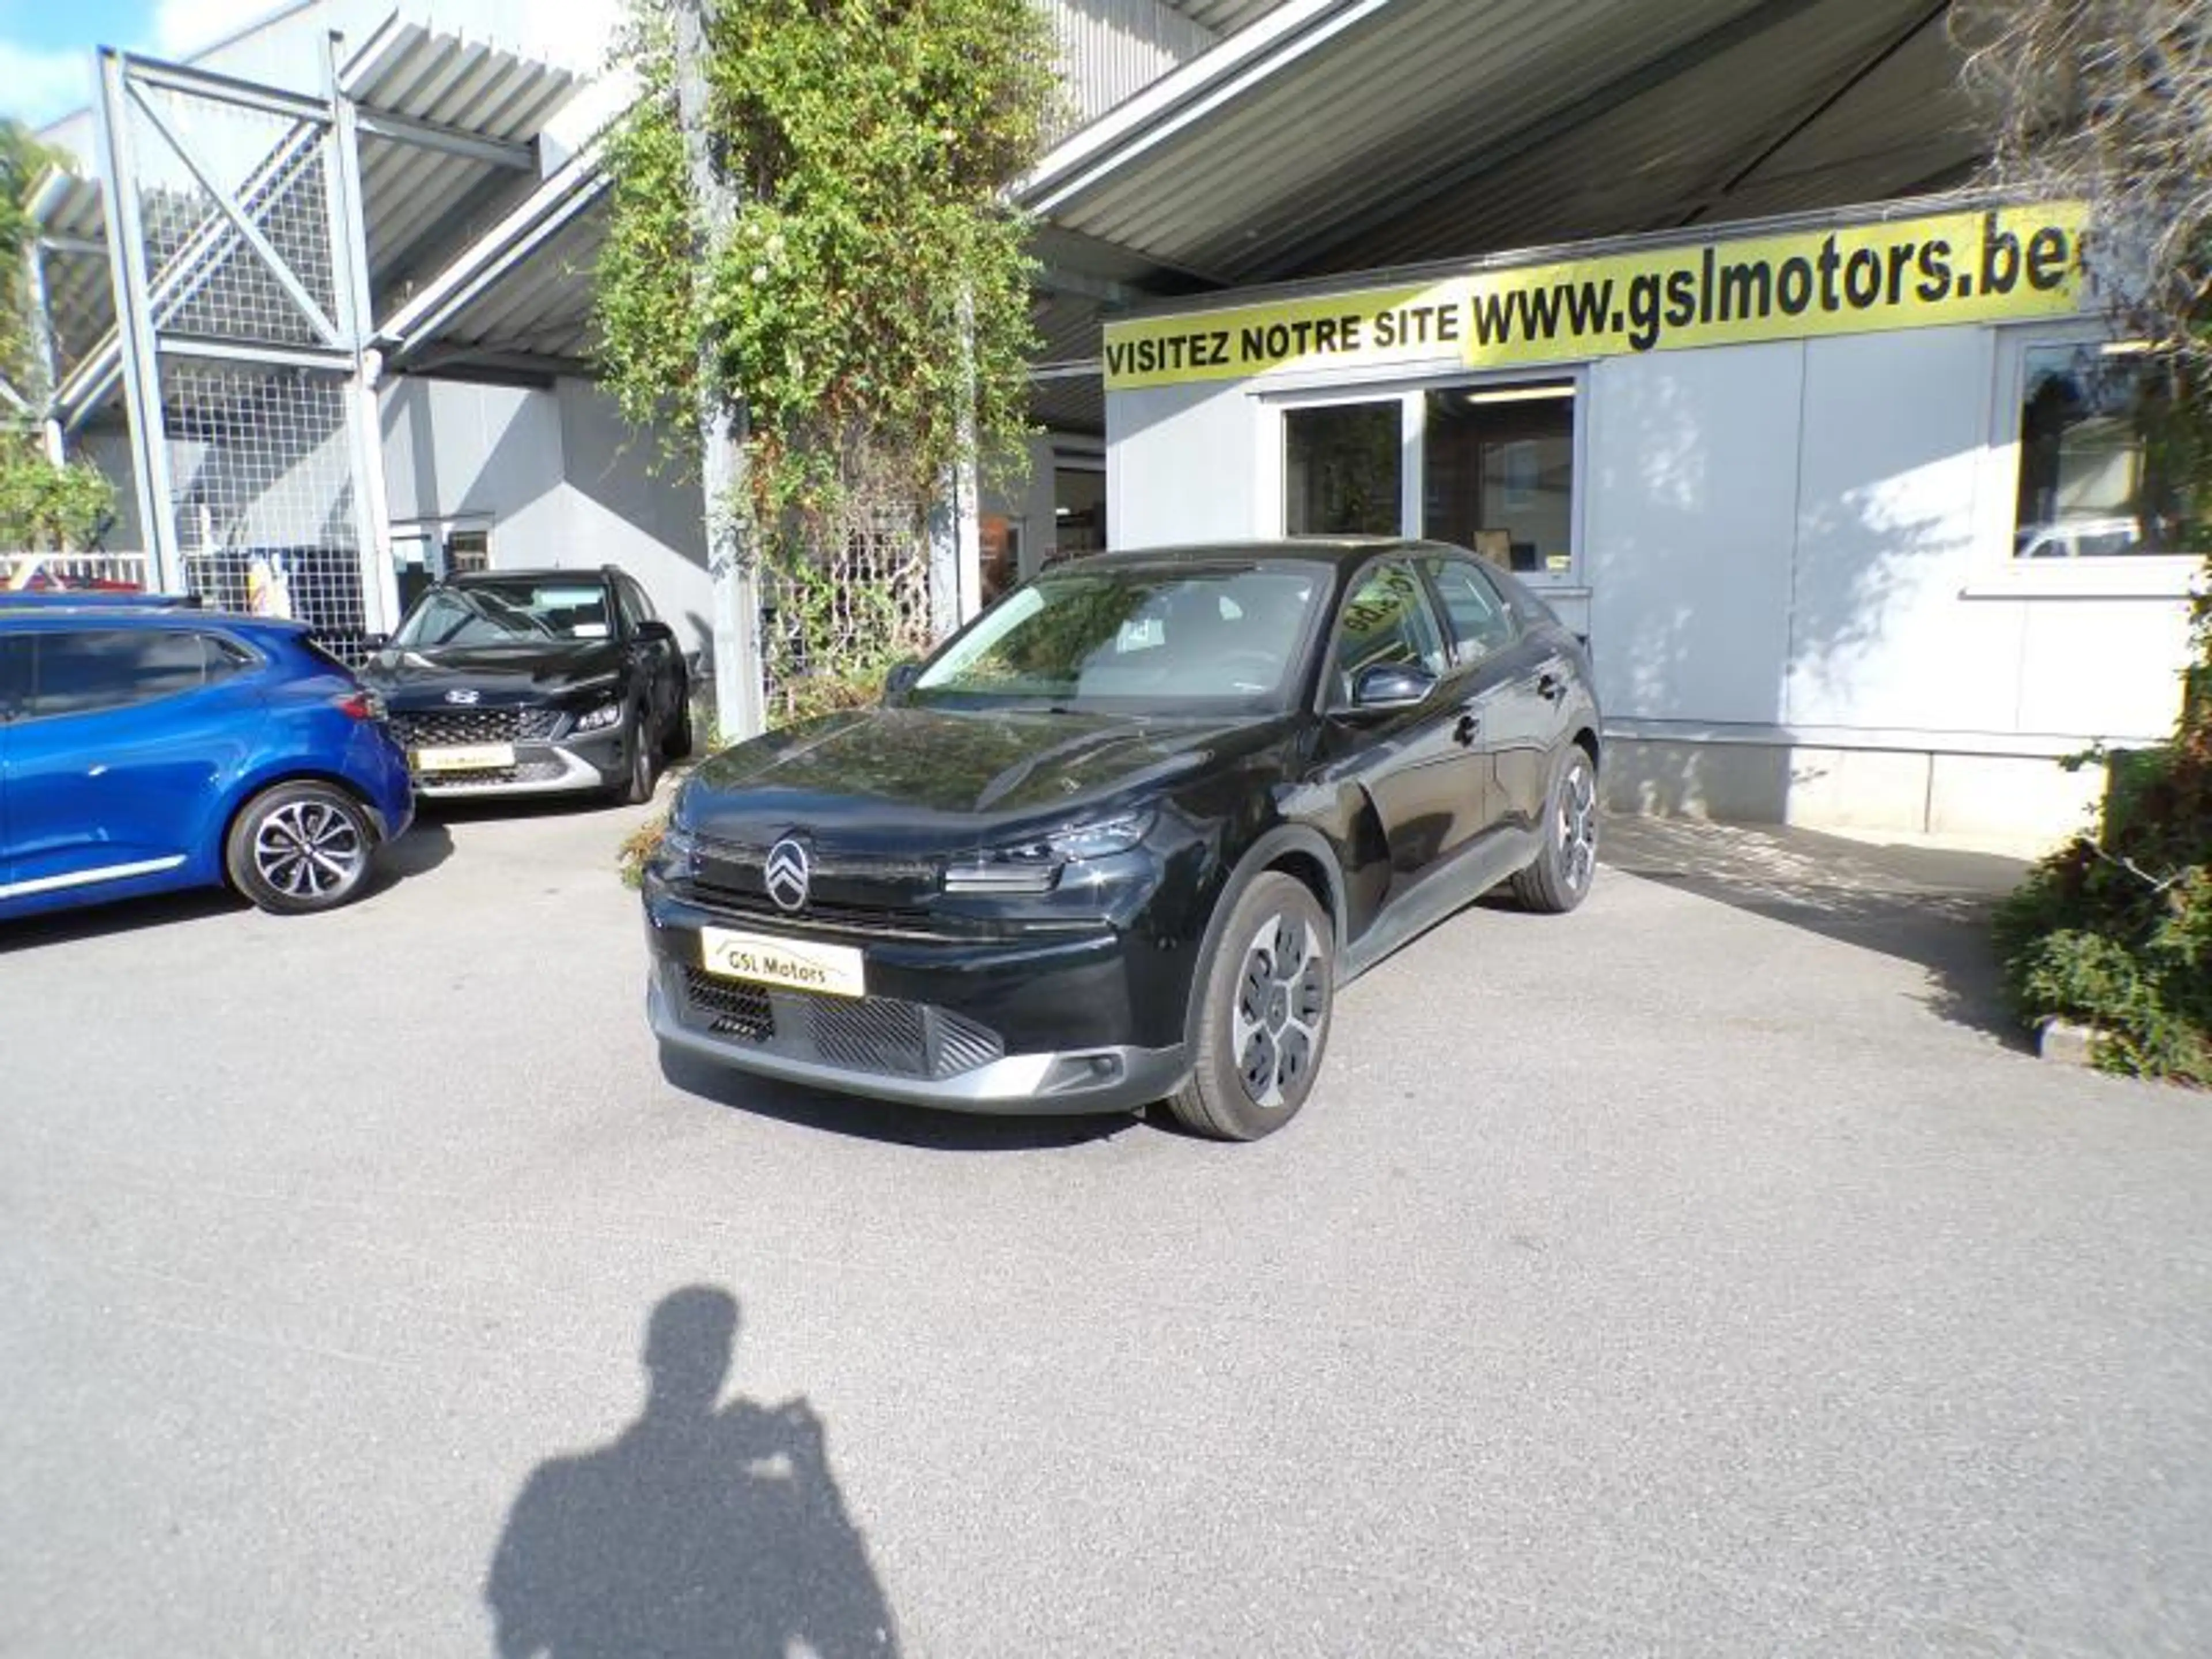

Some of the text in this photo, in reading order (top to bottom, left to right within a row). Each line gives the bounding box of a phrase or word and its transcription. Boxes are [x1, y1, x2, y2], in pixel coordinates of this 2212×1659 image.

[1105, 212, 2067, 376] VISITEZ NOTRE SITE www.gslmotors.be
[728, 951, 826, 983] GSL Motors
